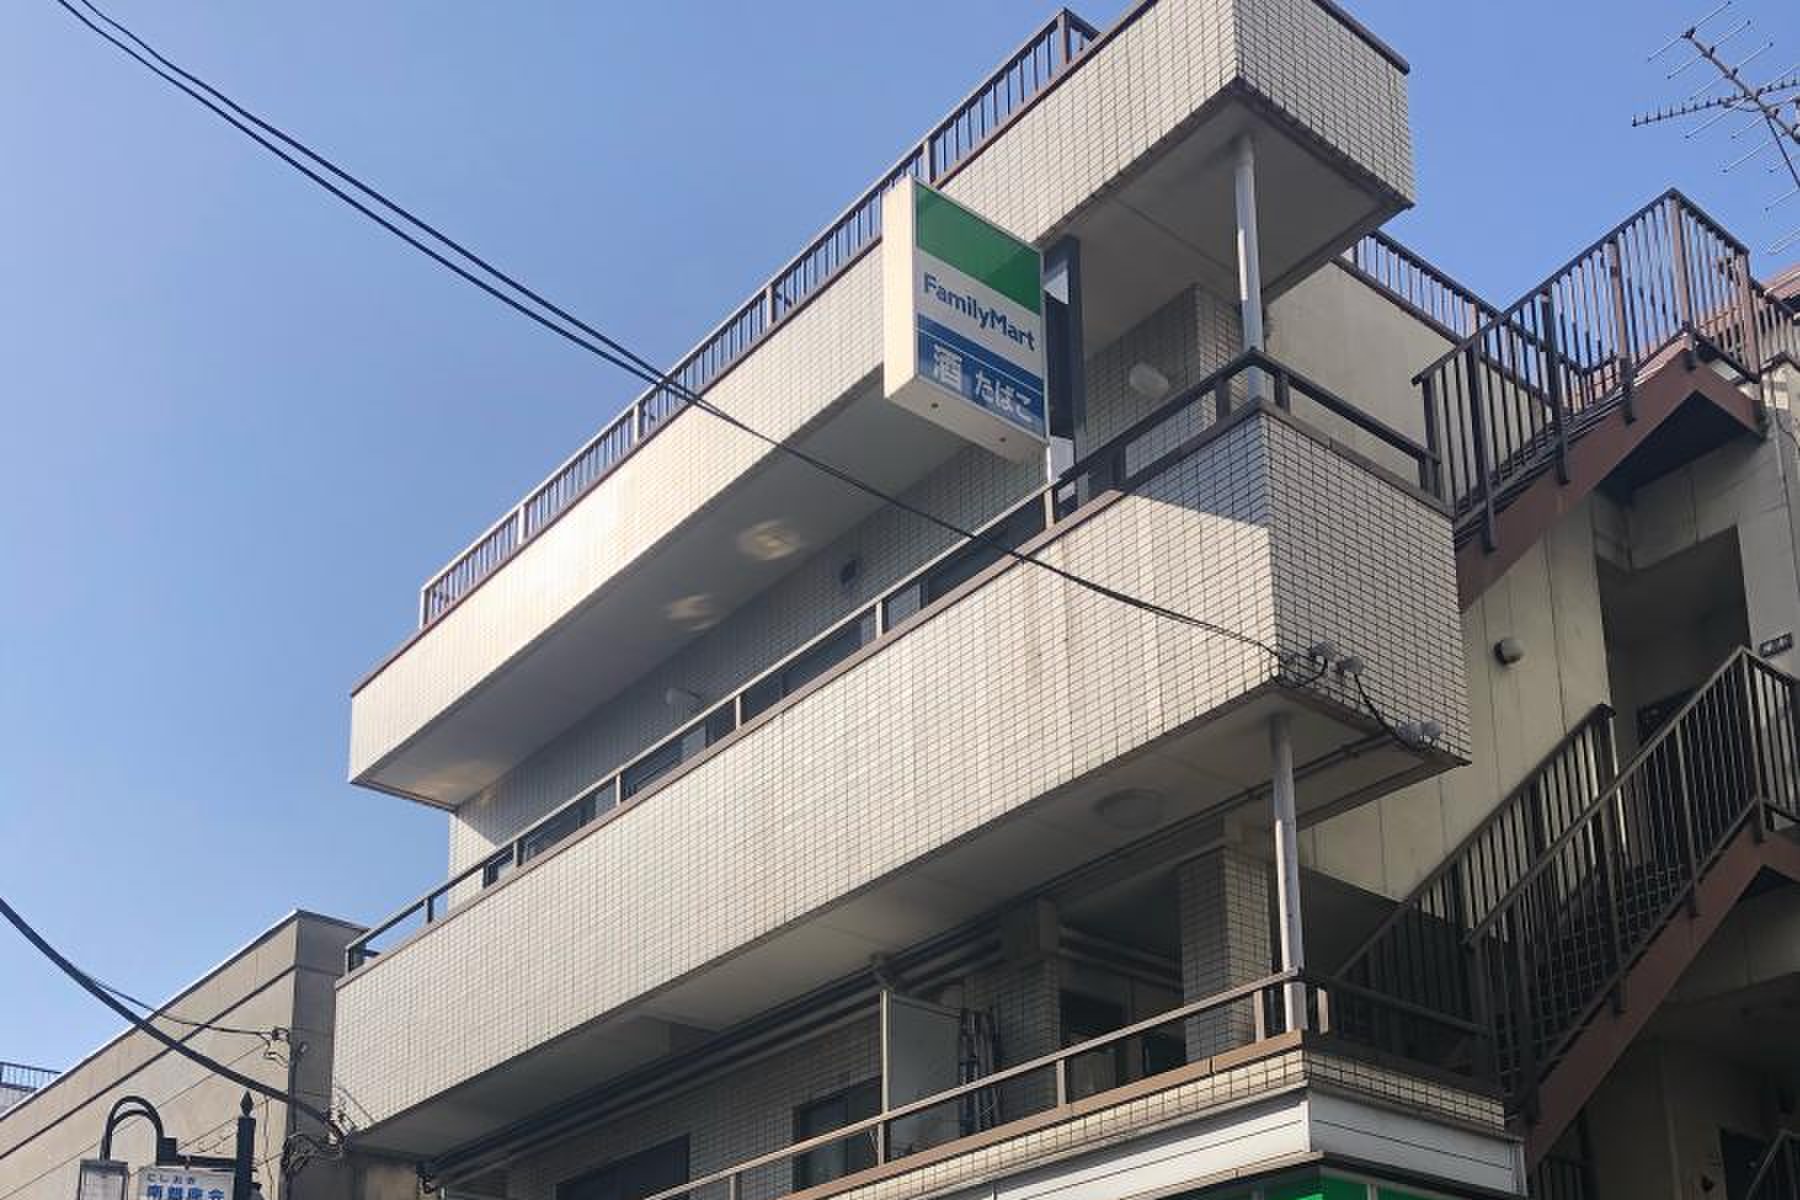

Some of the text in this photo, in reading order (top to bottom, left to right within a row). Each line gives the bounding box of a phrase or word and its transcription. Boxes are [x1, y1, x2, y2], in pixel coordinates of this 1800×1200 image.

[923, 271, 1036, 352] FamilyMart
[975, 369, 1033, 423] たばこ
